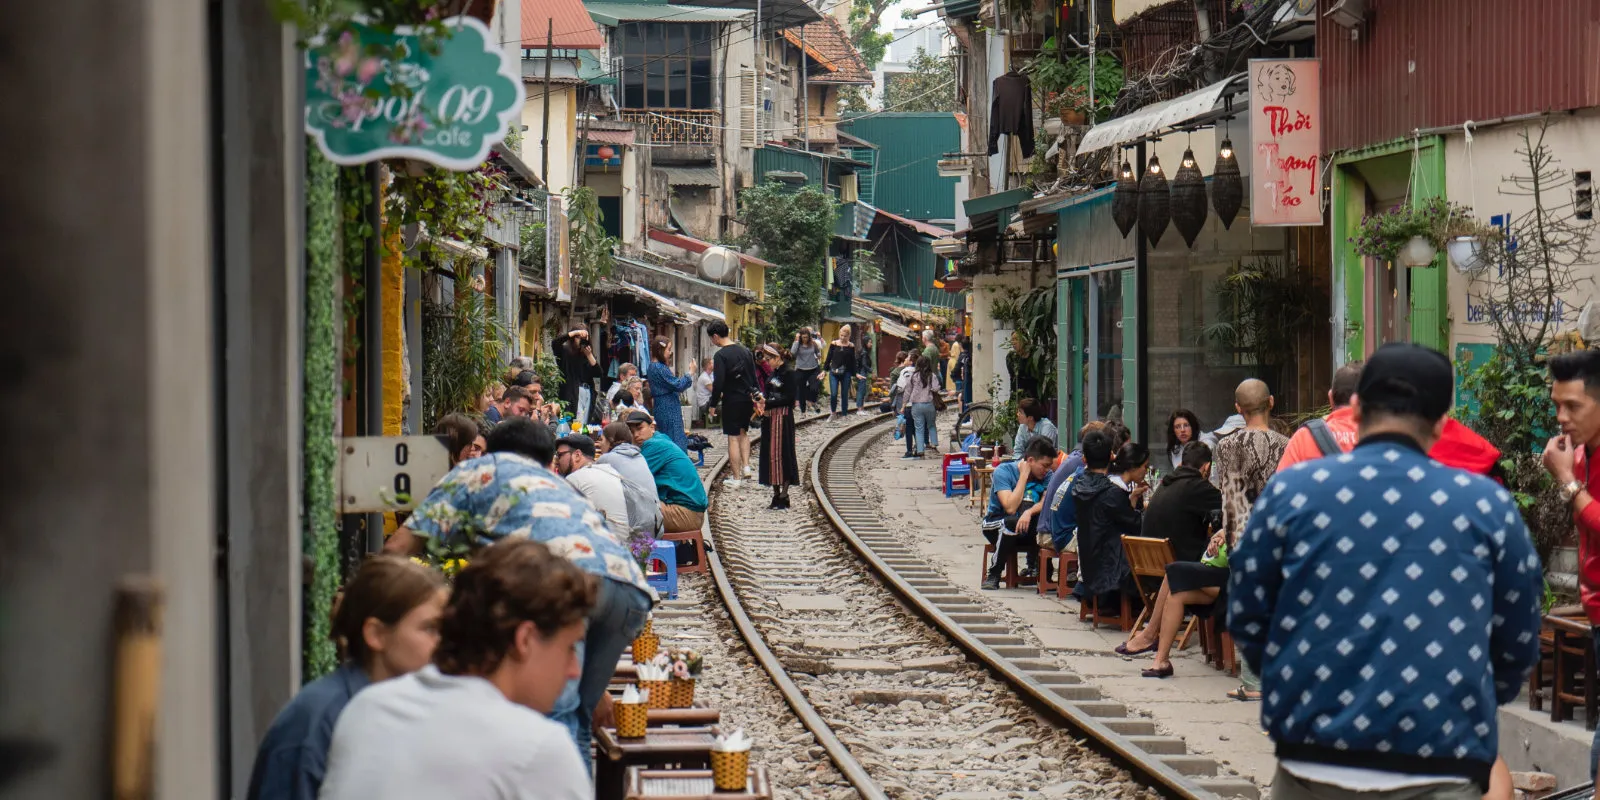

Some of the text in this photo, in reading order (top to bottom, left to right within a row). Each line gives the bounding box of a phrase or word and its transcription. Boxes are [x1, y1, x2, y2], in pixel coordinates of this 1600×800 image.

[438, 85, 493, 124] 09
[421, 124, 472, 147] Cafe
[1263, 106, 1312, 138] Thời
